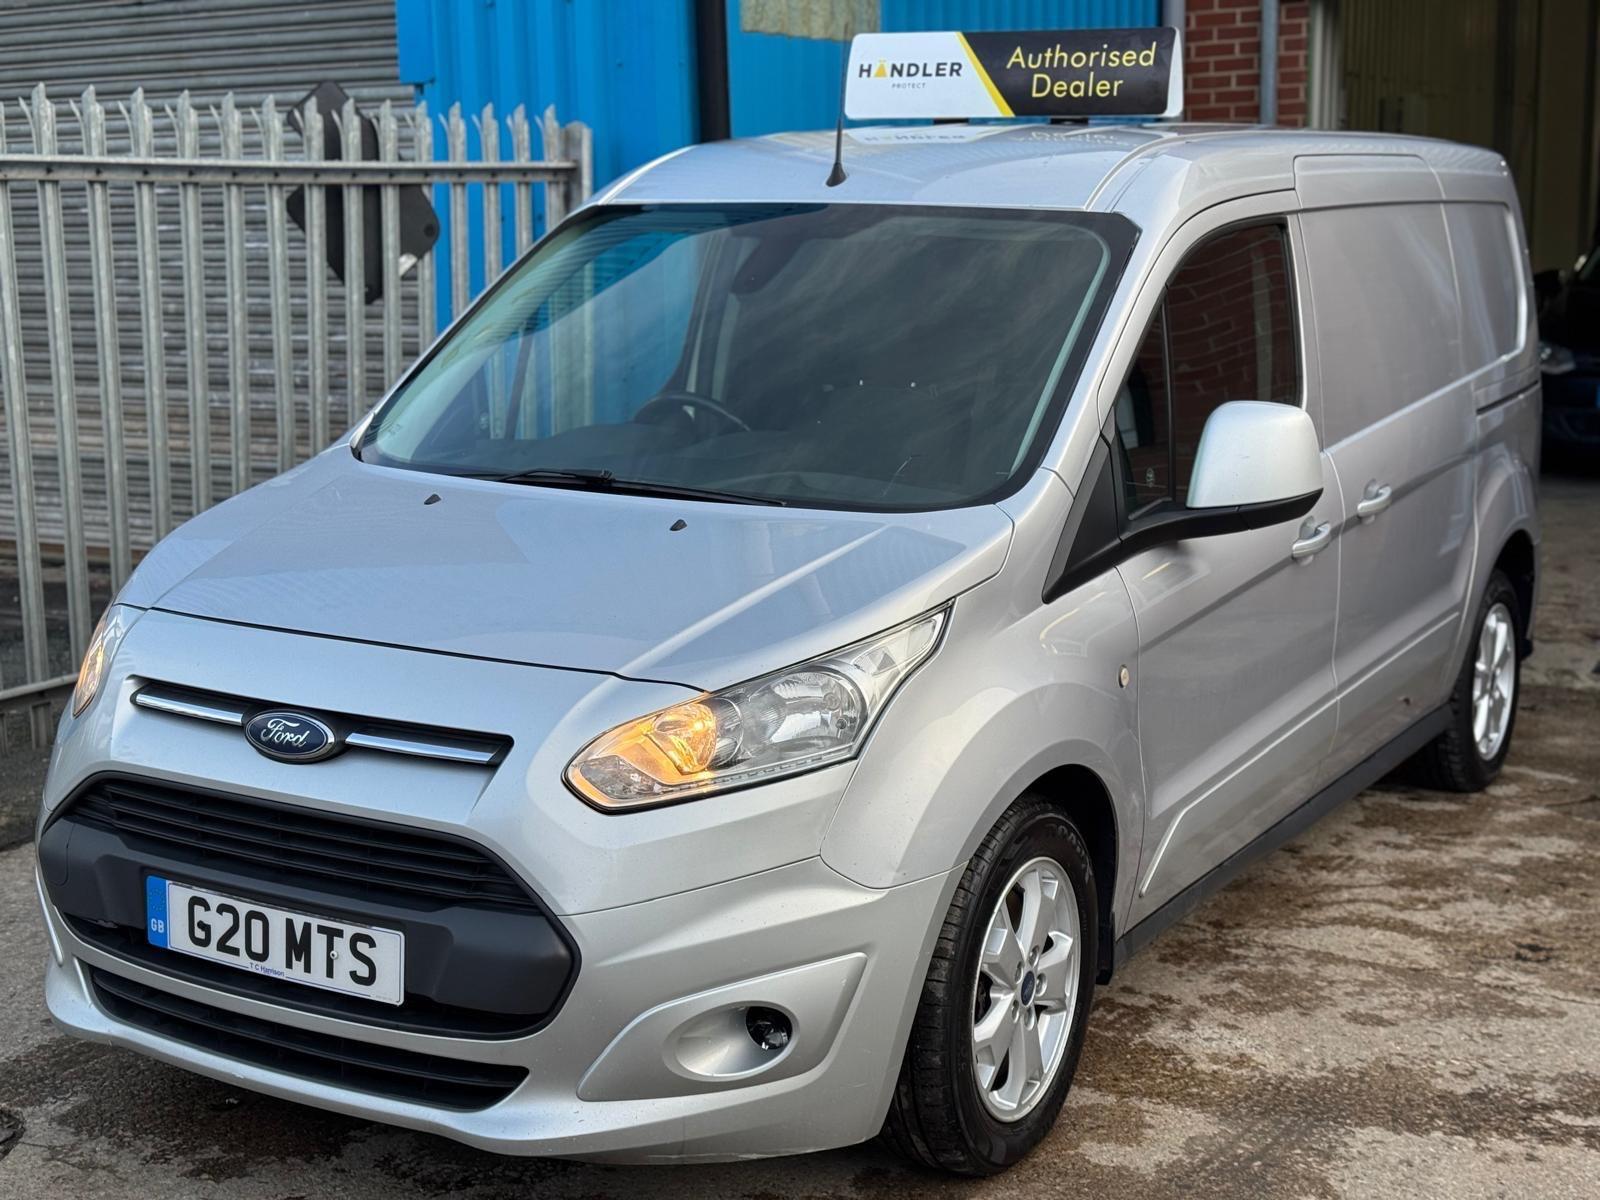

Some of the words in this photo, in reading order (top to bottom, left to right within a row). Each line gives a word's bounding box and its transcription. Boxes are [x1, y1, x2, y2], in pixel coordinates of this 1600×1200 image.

[858, 59, 963, 78] HÄNDLER
[1006, 41, 1157, 69] Authorised
[1031, 71, 1124, 98] Dealer
[260, 718, 310, 748] Ford
[151, 918, 165, 933] GB
[187, 895, 270, 963] G20
[285, 917, 377, 987] MTS
